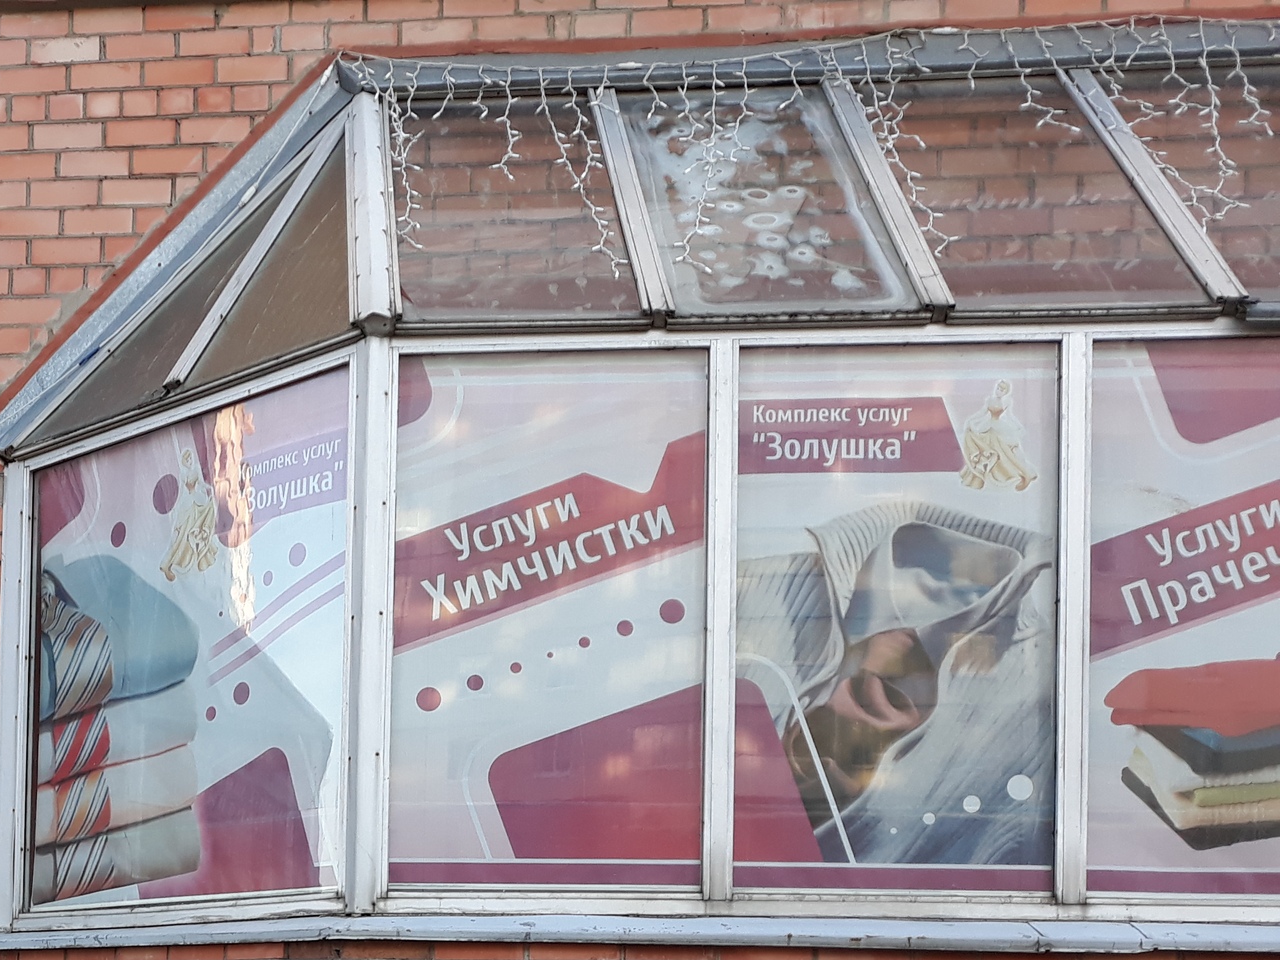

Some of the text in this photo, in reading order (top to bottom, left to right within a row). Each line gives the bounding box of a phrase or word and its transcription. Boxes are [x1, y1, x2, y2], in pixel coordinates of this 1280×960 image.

[753, 404, 912, 427] Комплекс услуг
[302, 438, 342, 467] услуг
[752, 430, 917, 466] "Золушка"
[444, 492, 581, 561] Услуги
[420, 504, 676, 621] Химчистки
